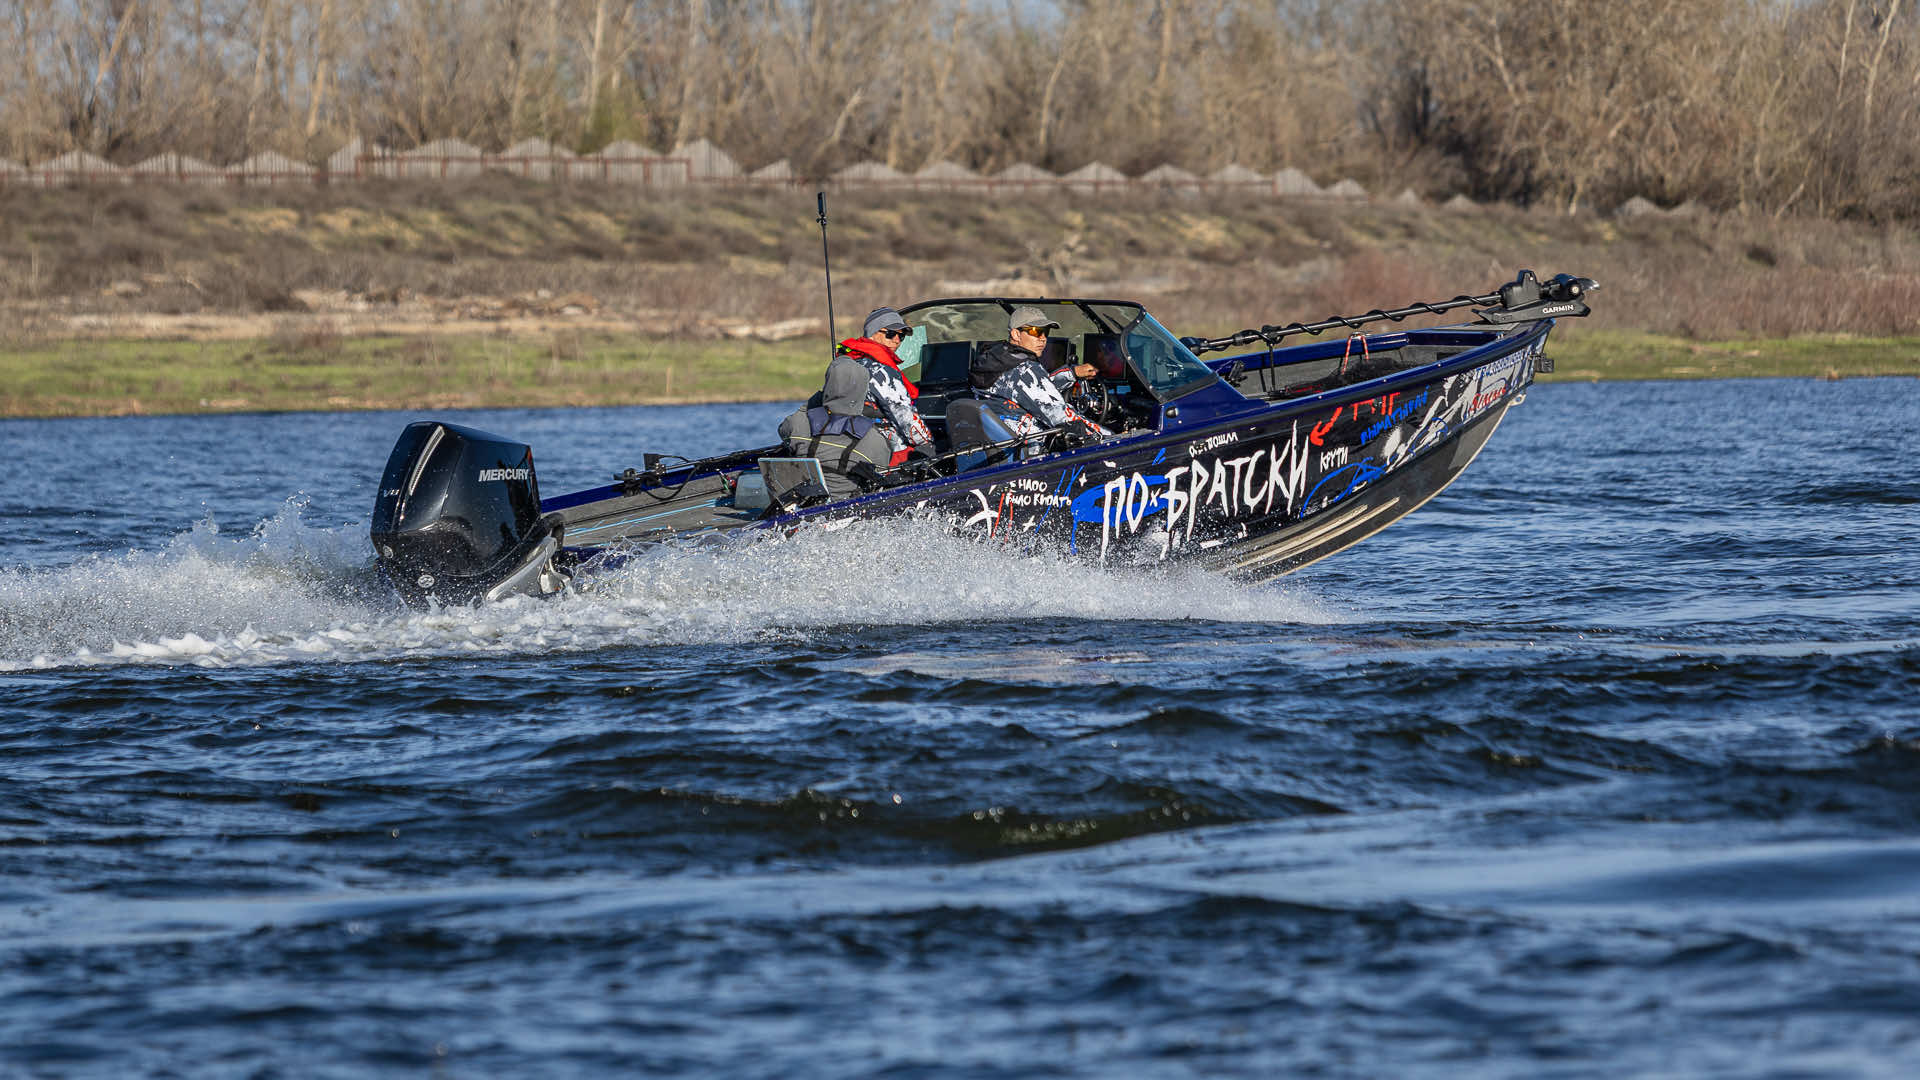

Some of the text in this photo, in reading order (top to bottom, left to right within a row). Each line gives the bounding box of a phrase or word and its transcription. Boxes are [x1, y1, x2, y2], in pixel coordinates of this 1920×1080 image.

[1542, 304, 1575, 314] GARMIN
[478, 468, 529, 482] MERCURY
[1159, 419, 1309, 543] БРАТСКИ
